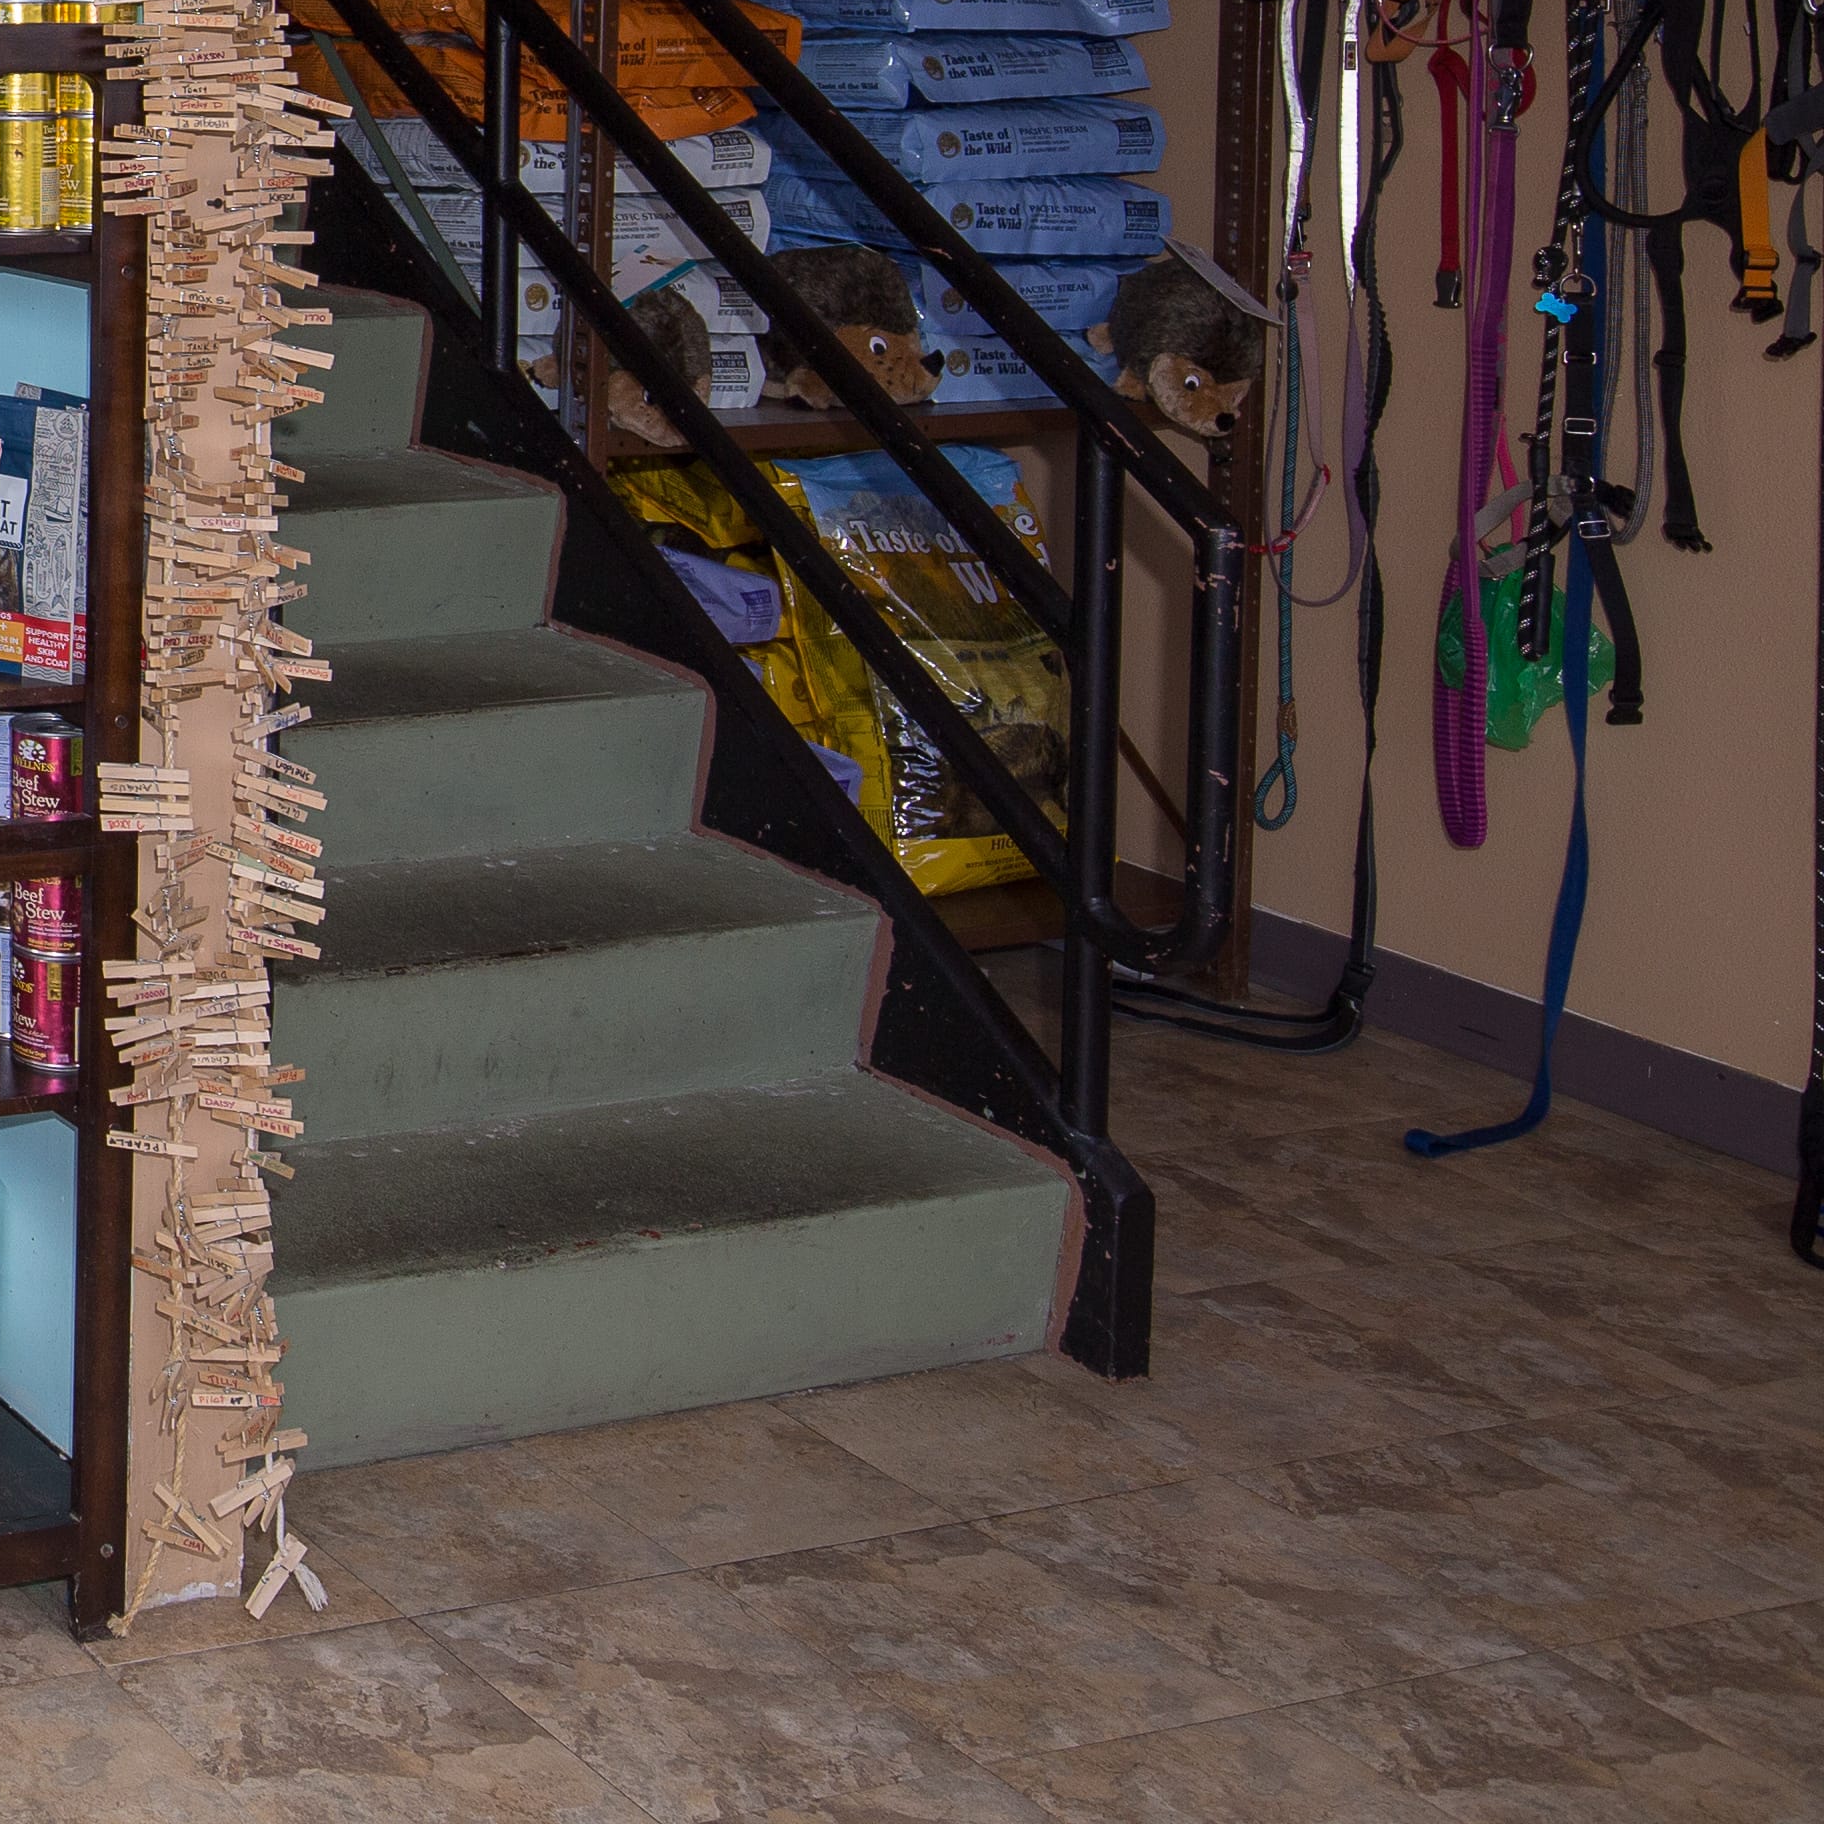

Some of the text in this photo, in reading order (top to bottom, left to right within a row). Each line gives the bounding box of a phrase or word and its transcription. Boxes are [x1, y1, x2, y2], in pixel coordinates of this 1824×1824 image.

[961, 129, 994, 142] Taste
[964, 142, 1012, 156] the Wild
[25, 627, 70, 642] SUPPORTS
[28, 637, 66, 650] HEALTHY
[37, 648, 57, 657] SKIN
[24, 654, 68, 668] AND COAT
[22, 789, 61, 809] Stew
